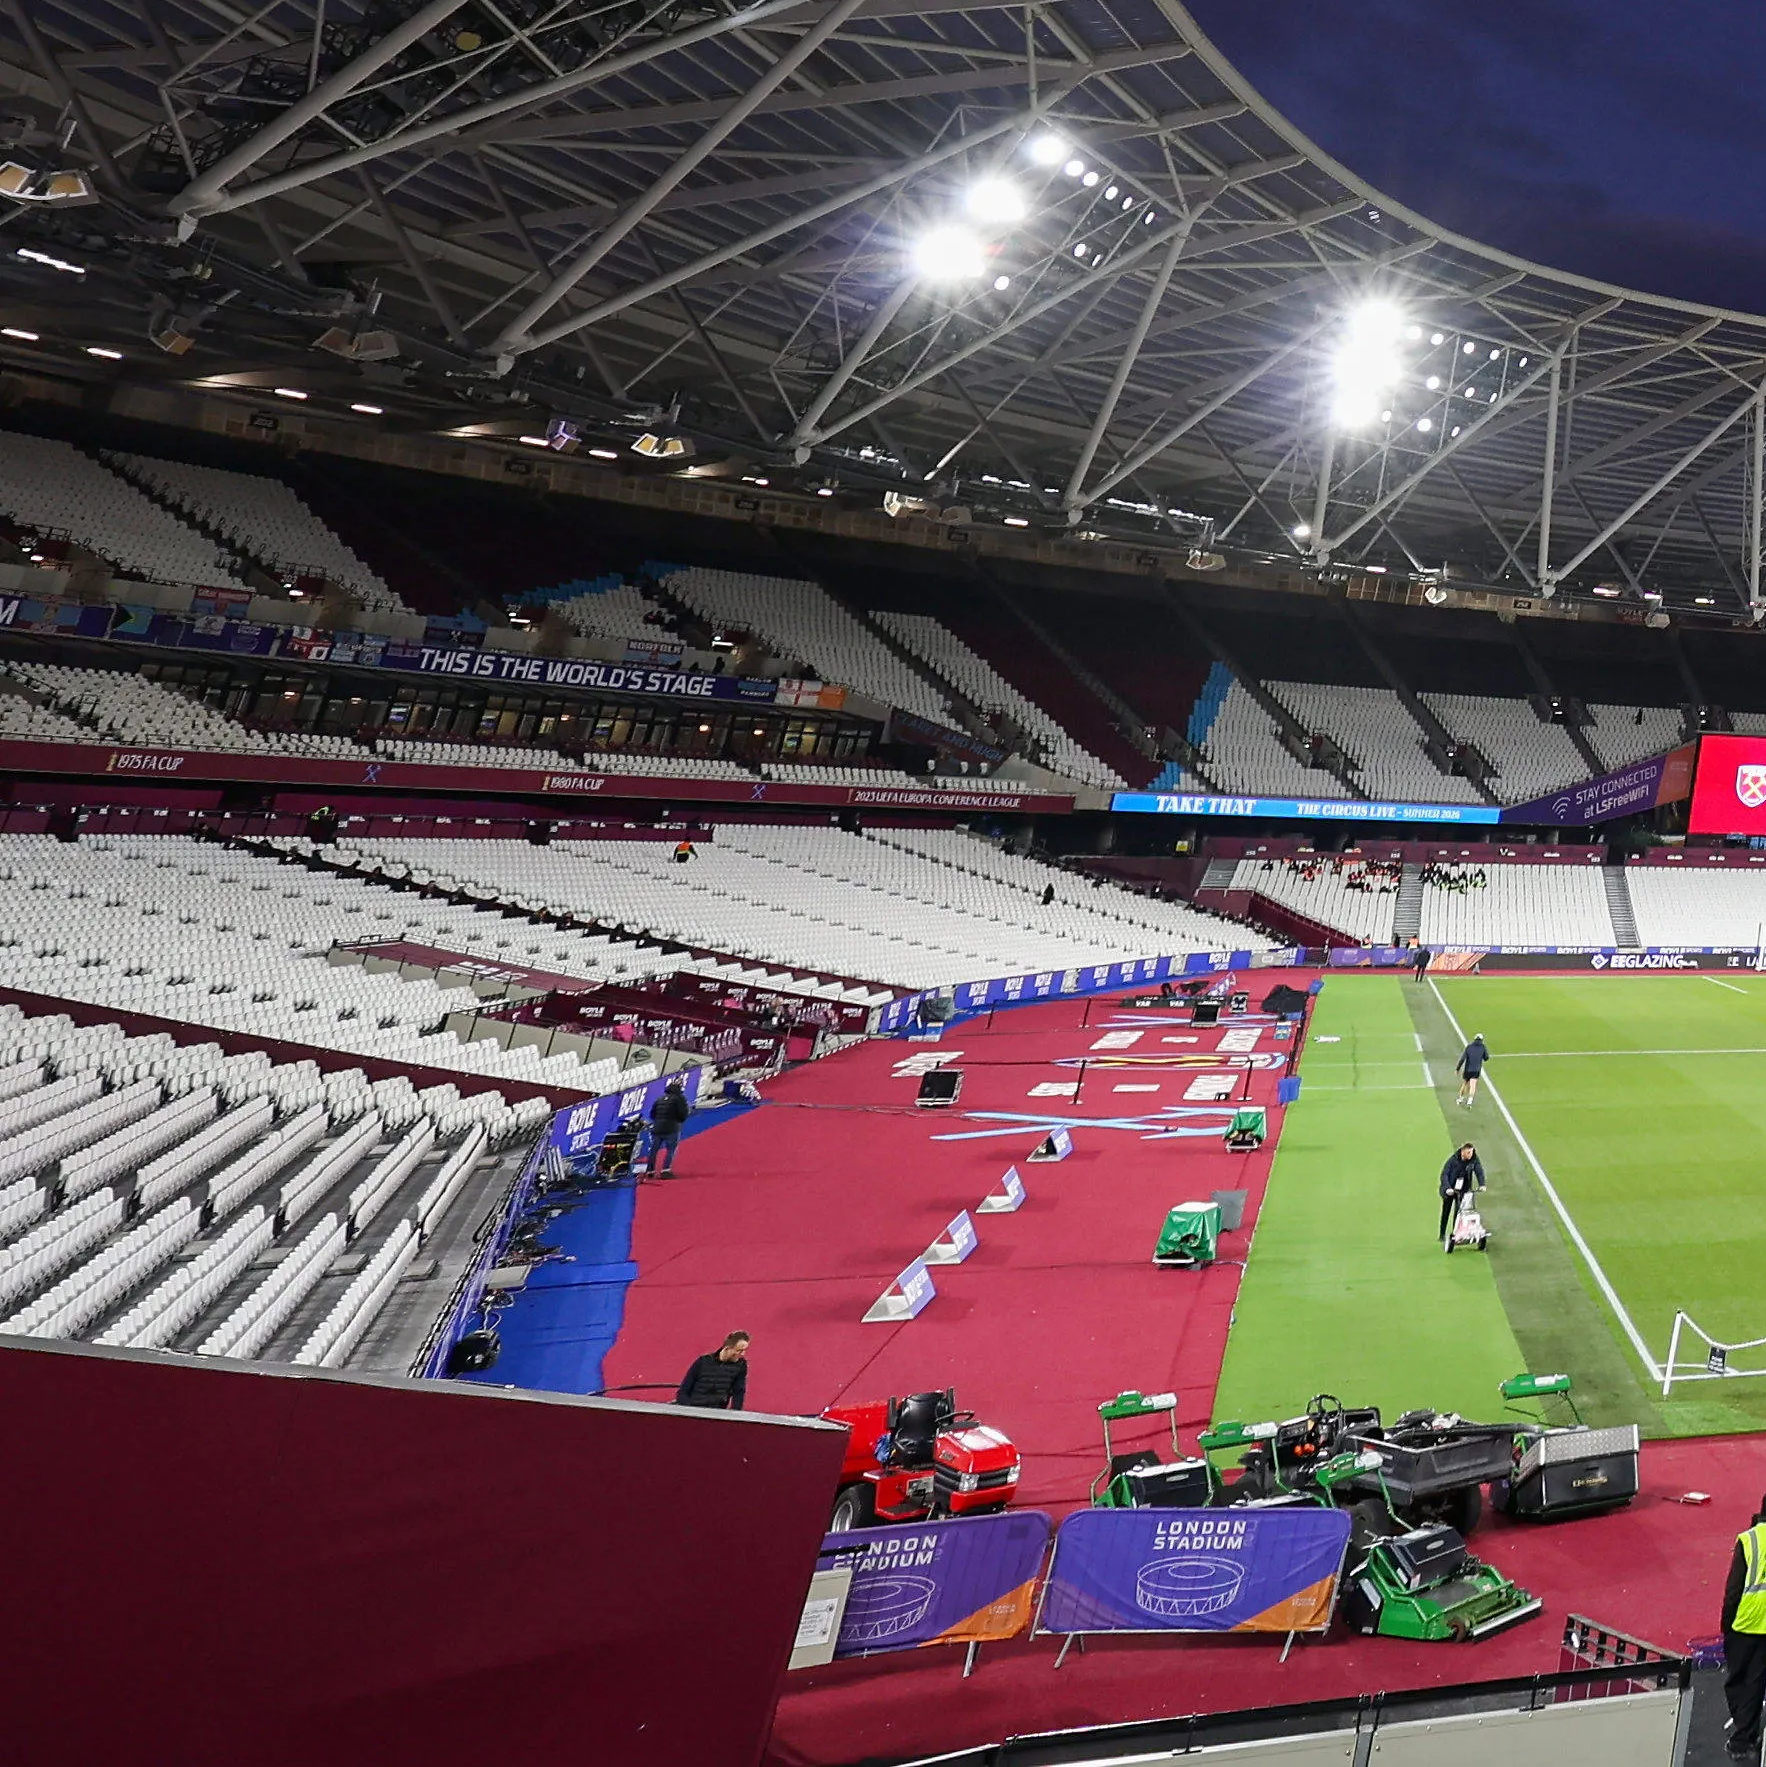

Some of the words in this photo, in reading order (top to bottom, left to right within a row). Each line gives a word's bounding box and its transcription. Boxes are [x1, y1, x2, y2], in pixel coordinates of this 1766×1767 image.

[420, 647, 469, 674] THIS
[472, 652, 494, 676] IS
[500, 655, 543, 681] THE
[546, 659, 643, 690] WORLD'S
[643, 671, 716, 697] STAGE
[117, 753, 141, 769] 1975
[141, 755, 157, 770] FA
[158, 756, 184, 772] CUP
[1575, 785, 1600, 805] STAY
[1601, 765, 1657, 795] CONNECTED
[1156, 795, 1205, 813] TAKE
[1207, 796, 1257, 815] THAT
[1322, 804, 1367, 817] CIRCUS
[1370, 805, 1396, 818] LIVE
[1610, 954, 1684, 969] EEGLAZING
[618, 1086, 648, 1117] BOYLE
[566, 1101, 600, 1136] BOYLE
[1156, 1521, 1246, 1535] LONDON
[834, 1535, 937, 1560] NDON
[1153, 1535, 1244, 1550] STADIUM
